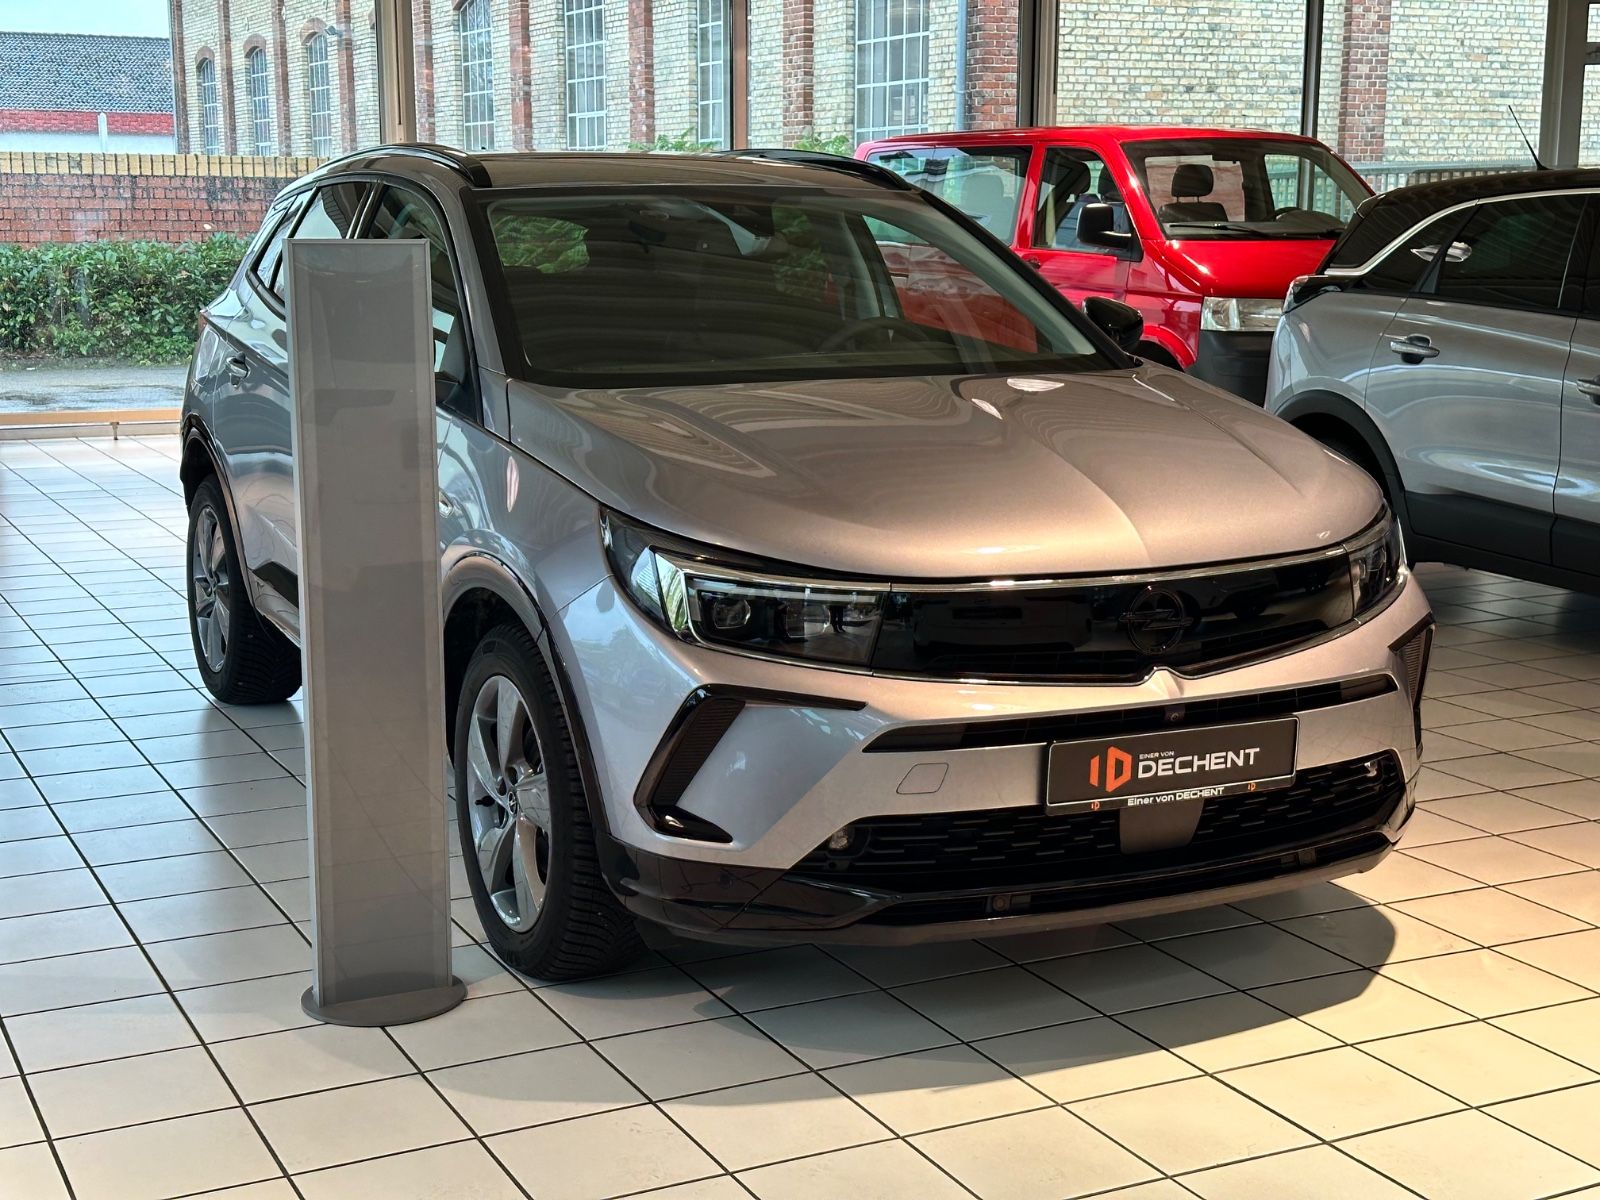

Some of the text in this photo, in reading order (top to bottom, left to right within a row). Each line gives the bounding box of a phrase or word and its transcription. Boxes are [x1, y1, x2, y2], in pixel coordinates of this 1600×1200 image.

[1138, 748, 1260, 779] DECHENT
[1139, 752, 1160, 760] EINER
[1127, 787, 1225, 806] Einer von DECHENT
